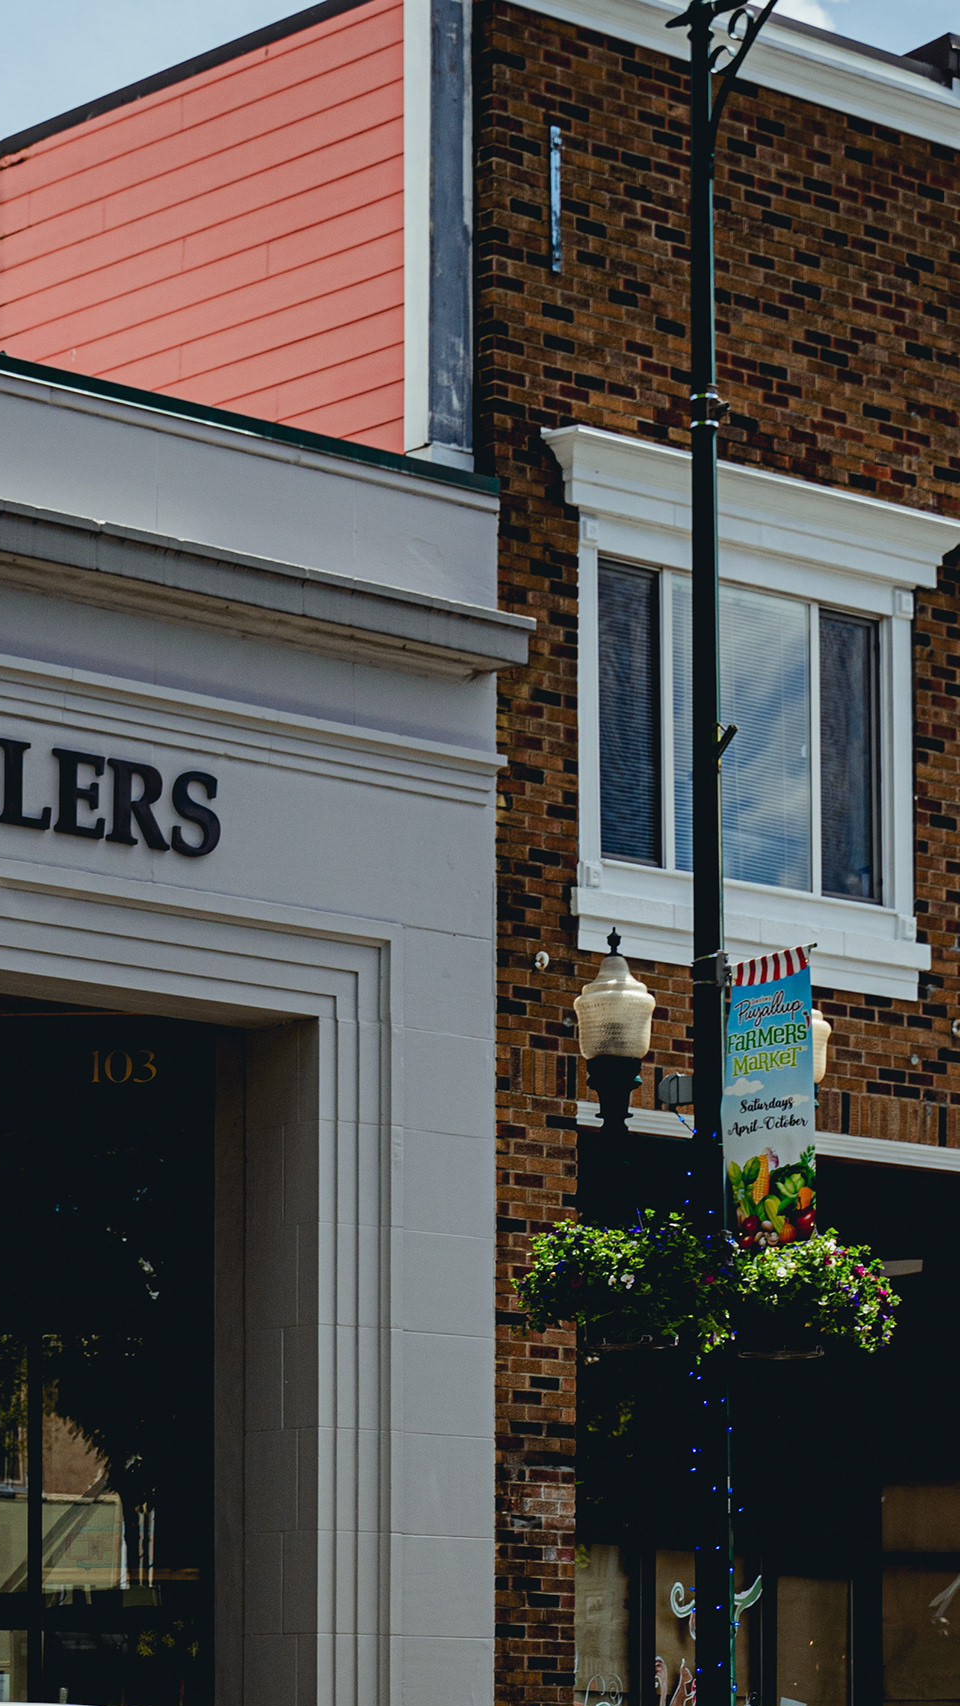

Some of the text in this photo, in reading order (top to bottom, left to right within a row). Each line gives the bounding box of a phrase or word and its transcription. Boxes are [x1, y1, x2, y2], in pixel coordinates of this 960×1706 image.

[734, 990, 803, 1027] Puyallup
[91, 1050, 157, 1083] 103
[740, 1097, 794, 1113] Saturdays
